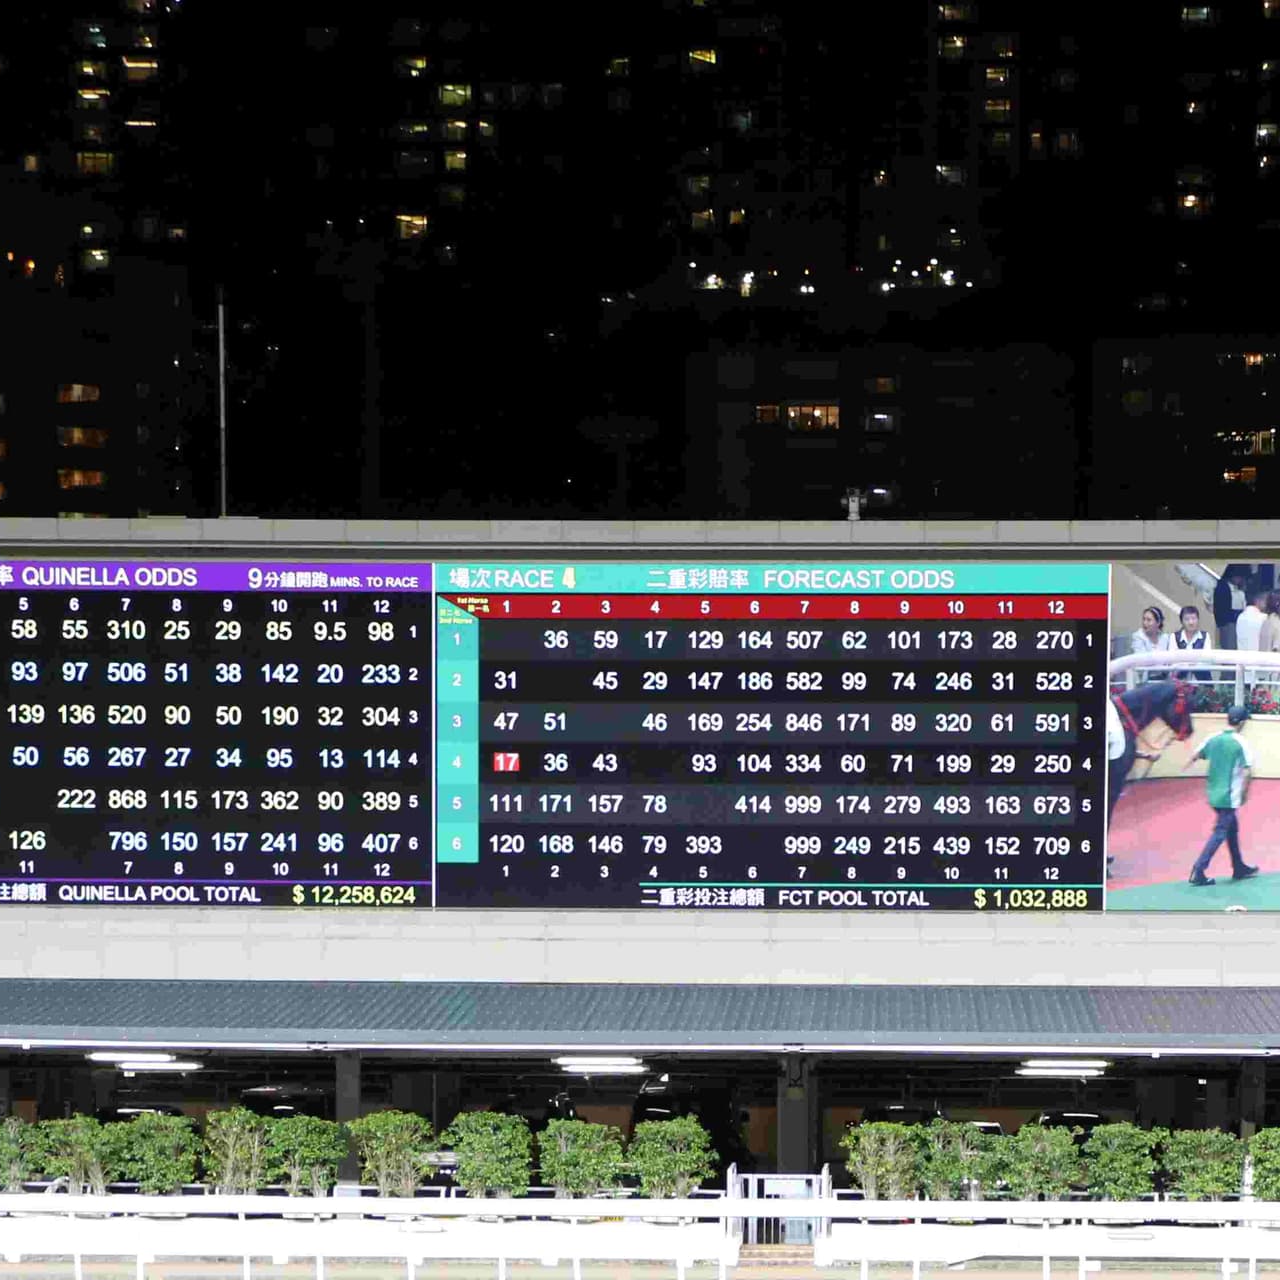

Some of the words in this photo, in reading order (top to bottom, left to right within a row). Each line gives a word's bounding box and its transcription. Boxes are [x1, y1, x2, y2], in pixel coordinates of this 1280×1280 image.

[22, 567, 129, 585] QUINELLA
[135, 568, 197, 586] ODDS
[330, 576, 363, 588] MINS.
[366, 576, 383, 588] TO
[385, 576, 419, 588] RACE
[449, 568, 490, 589] 場次
[494, 569, 554, 588] RACE
[561, 567, 576, 588] 4
[764, 570, 885, 588] FORECAST
[890, 570, 954, 589] ODDS
[503, 600, 509, 613] 1
[552, 600, 560, 613] 2
[602, 600, 610, 613] 3
[651, 601, 660, 613] 4
[701, 601, 710, 613] 5
[750, 601, 759, 613] 6
[801, 601, 809, 613] 7
[850, 601, 859, 614] 8
[901, 601, 909, 614] 9
[948, 601, 964, 613] 10
[998, 601, 1012, 613] 11
[1048, 601, 1064, 614] 12
[12, 620, 37, 638] 58
[63, 620, 88, 639] 55
[107, 620, 145, 639] 310
[164, 621, 190, 639] 25
[215, 621, 241, 640] 29
[266, 621, 292, 640] 85
[314, 622, 346, 640] 9.5
[368, 622, 394, 641] 98
[410, 625, 416, 638] 1
[454, 632, 460, 645] 1
[544, 630, 568, 648] 36
[594, 631, 618, 648] 59
[645, 631, 667, 648] 17
[689, 631, 723, 649] 129
[738, 631, 773, 649] 164
[787, 631, 823, 649] 507
[842, 631, 866, 649] 62
[888, 631, 920, 649] 101
[938, 631, 972, 649] 173
[992, 631, 1017, 649] 28
[1037, 631, 1073, 649] 270
[1086, 634, 1092, 646] 1
[58, 789, 96, 808] 222
[109, 790, 147, 808] 868
[161, 790, 197, 809] 115
[212, 791, 248, 809] 173
[261, 791, 299, 809] 362
[318, 791, 343, 810] 90
[362, 792, 400, 810] 389
[409, 795, 418, 808] 5
[58, 884, 146, 902] QUINELLA
[150, 885, 199, 902] POOL
[203, 885, 262, 903] TOTAL
[293, 885, 304, 904] $
[311, 886, 416, 906] 12,258,624
[779, 890, 813, 905] FCT
[818, 890, 866, 905] POOL
[872, 891, 929, 906] TOTAL
[974, 888, 986, 908] $
[994, 890, 1087, 909] 1,032,888
